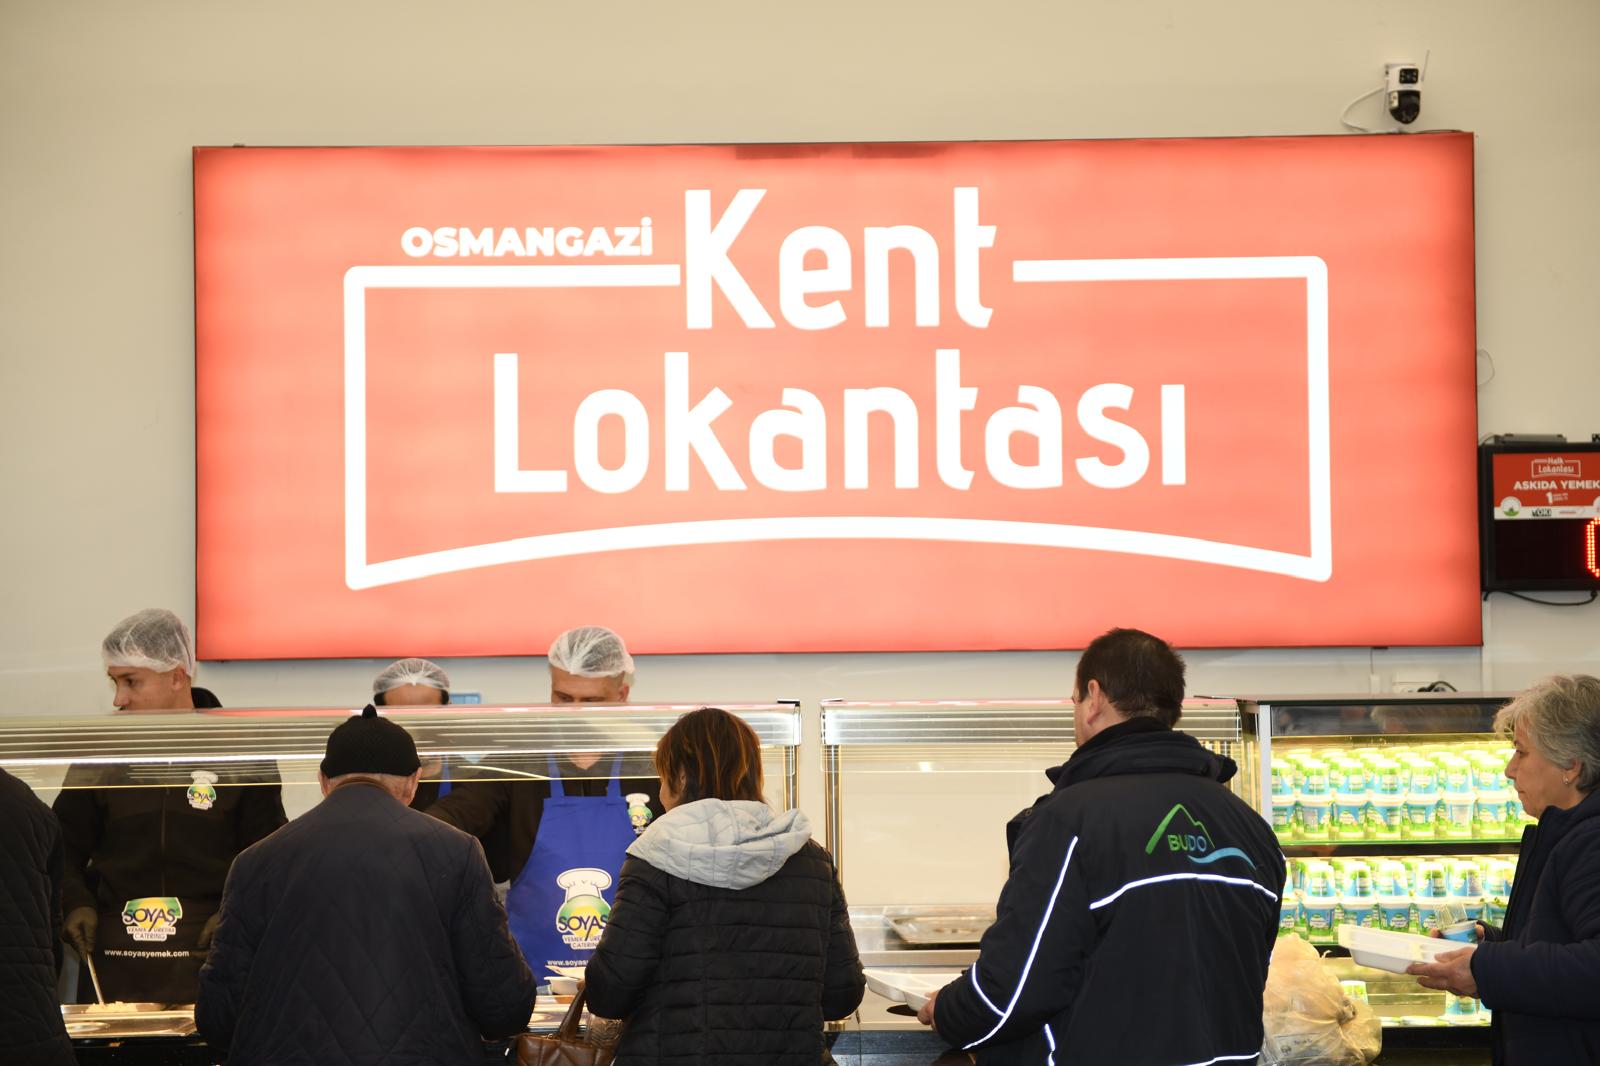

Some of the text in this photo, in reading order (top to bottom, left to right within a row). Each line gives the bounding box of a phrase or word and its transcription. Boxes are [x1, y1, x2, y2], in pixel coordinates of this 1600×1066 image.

[401, 217, 654, 258] OSMANGAZİ
[684, 186, 998, 331] Kent
[493, 348, 1187, 494] Lokantası
[1513, 480, 1600, 491] ASKIDA YEMEK
[1168, 834, 1207, 852] BUDO
[104, 949, 190, 958] www.soyasyemek.com
